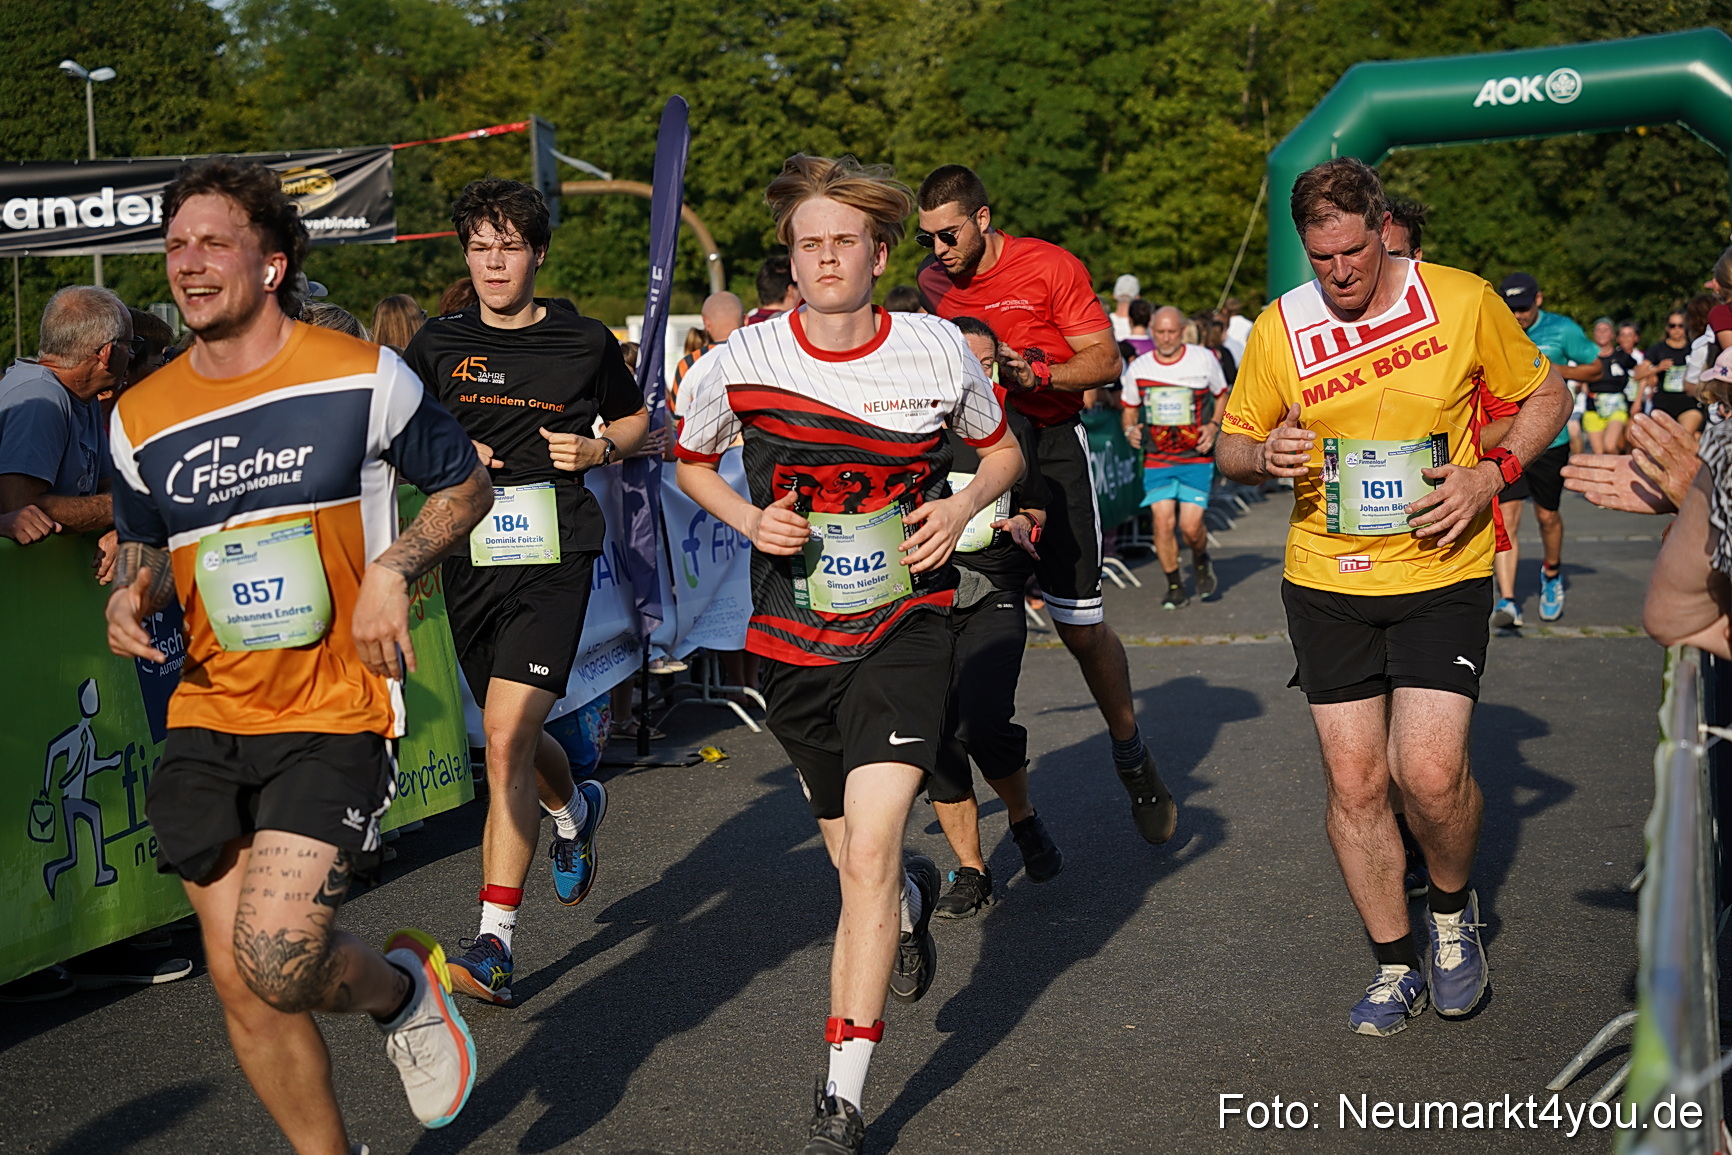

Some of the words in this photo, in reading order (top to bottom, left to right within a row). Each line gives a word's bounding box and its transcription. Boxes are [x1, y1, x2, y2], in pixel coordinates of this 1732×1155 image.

[1472, 74, 1546, 108] AOK
[451, 356, 488, 382] 45
[477, 371, 506, 380] JAHRE
[1302, 367, 1367, 408] MAX
[1371, 335, 1449, 379] BÖGL
[459, 393, 478, 403] auf
[479, 394, 526, 407] solidem
[527, 398, 566, 413] Grund!
[863, 398, 931, 413] NEUMARKT
[191, 445, 314, 495] Fischer
[206, 469, 303, 506] AUTOMOBILE
[1361, 480, 1404, 499] 1611
[1359, 503, 1390, 512] Johann
[492, 514, 530, 532] 184
[591, 540, 632, 591] AN
[820, 551, 887, 577] 2642
[232, 576, 285, 606] 857
[826, 579, 856, 590] Simon
[857, 573, 889, 589] Niebler
[226, 612, 273, 625] Johannes
[275, 604, 313, 618] Endres
[577, 650, 614, 685] MORGEN
